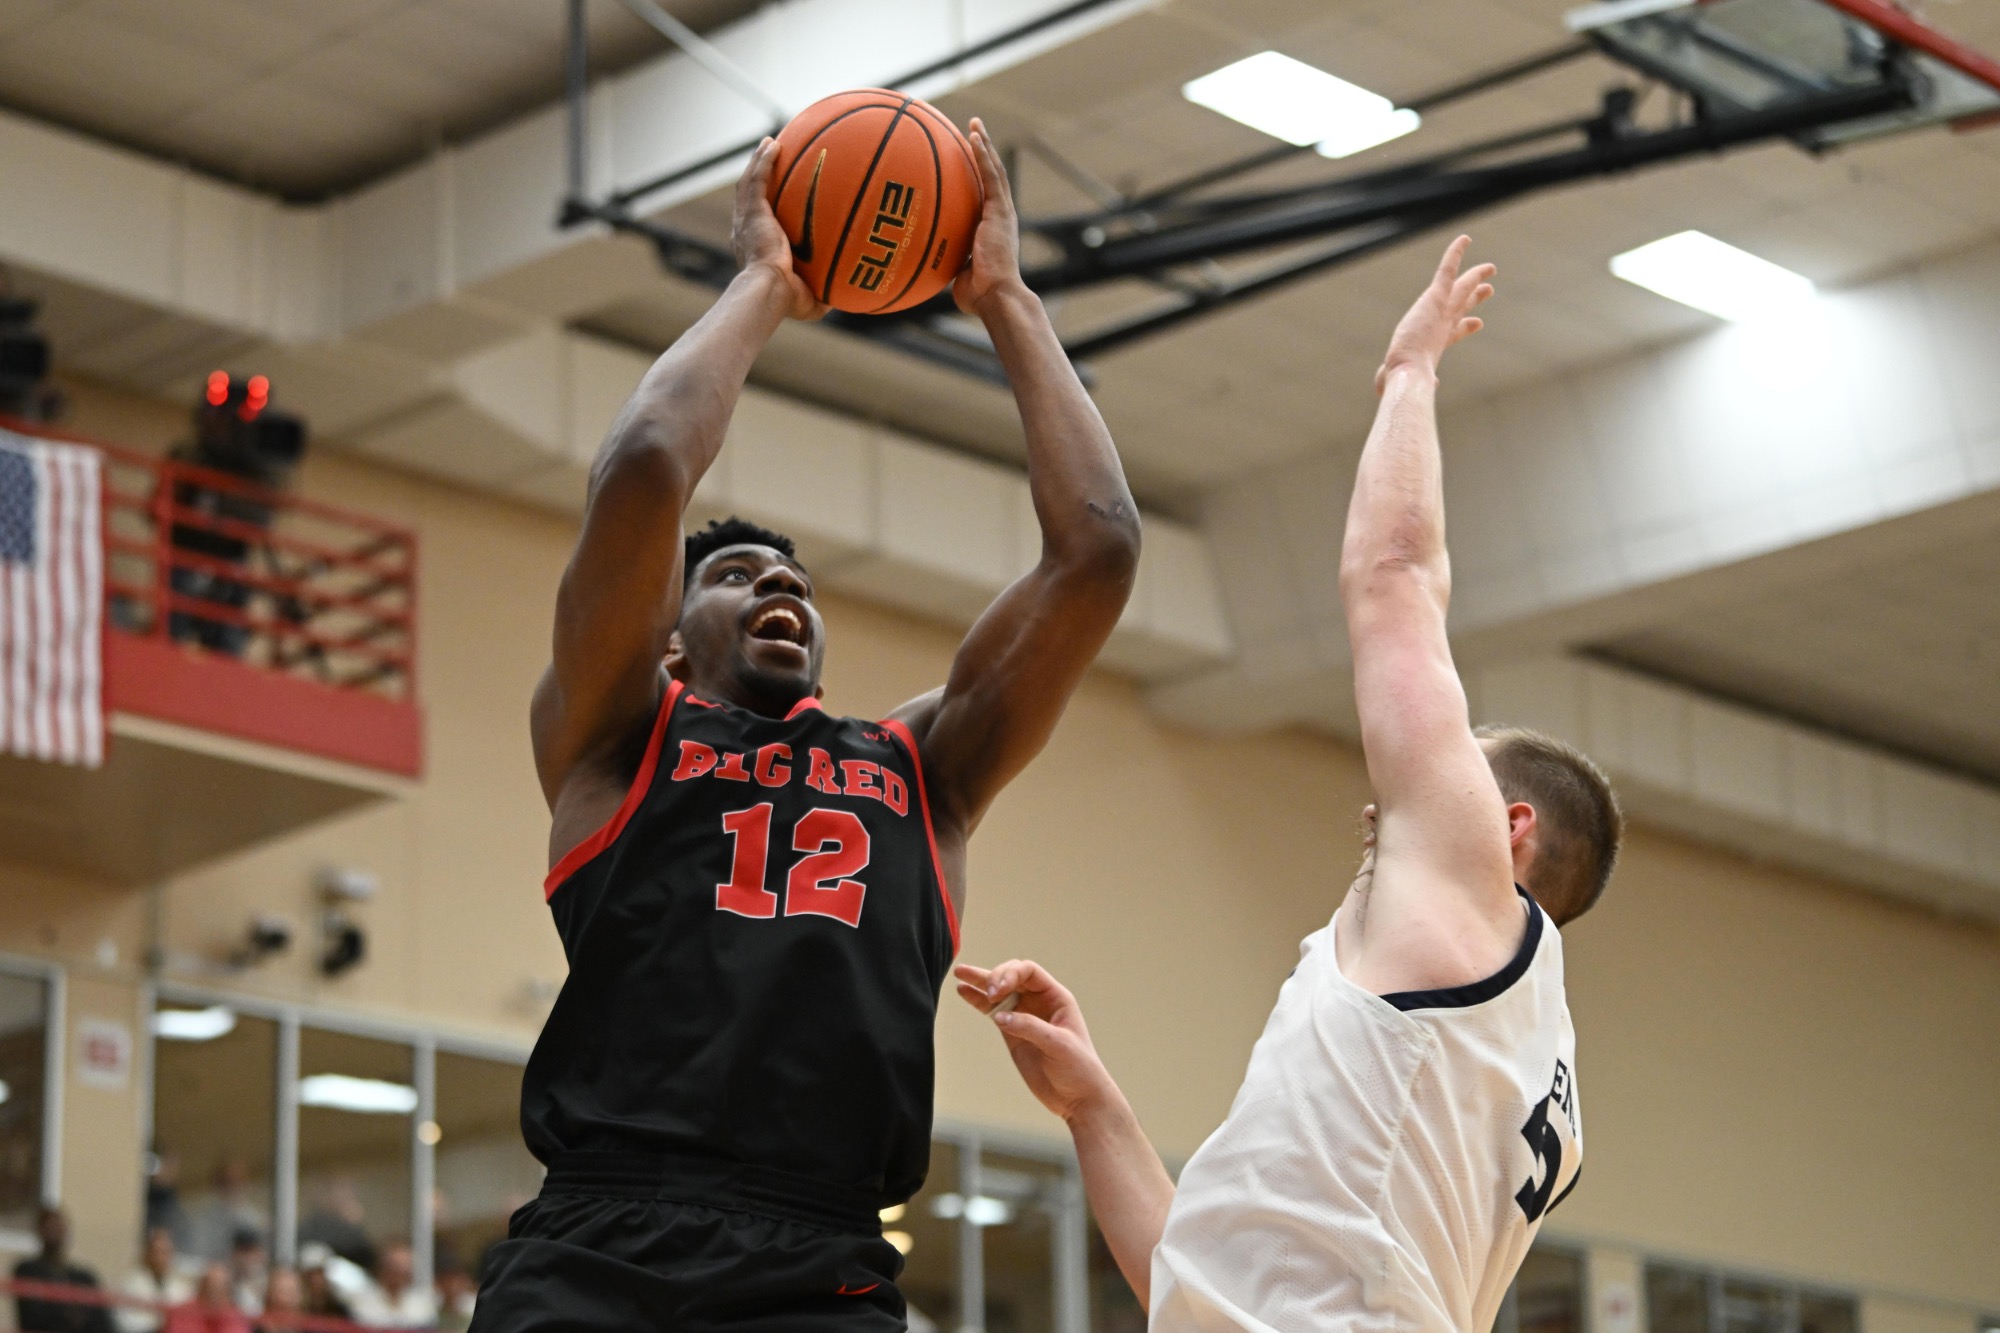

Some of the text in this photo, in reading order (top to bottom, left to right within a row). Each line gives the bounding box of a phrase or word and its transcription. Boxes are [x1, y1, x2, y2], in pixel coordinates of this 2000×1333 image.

[848, 181, 916, 292] ELITE
[671, 740, 909, 818] BIG RED
[715, 802, 871, 928] 12
